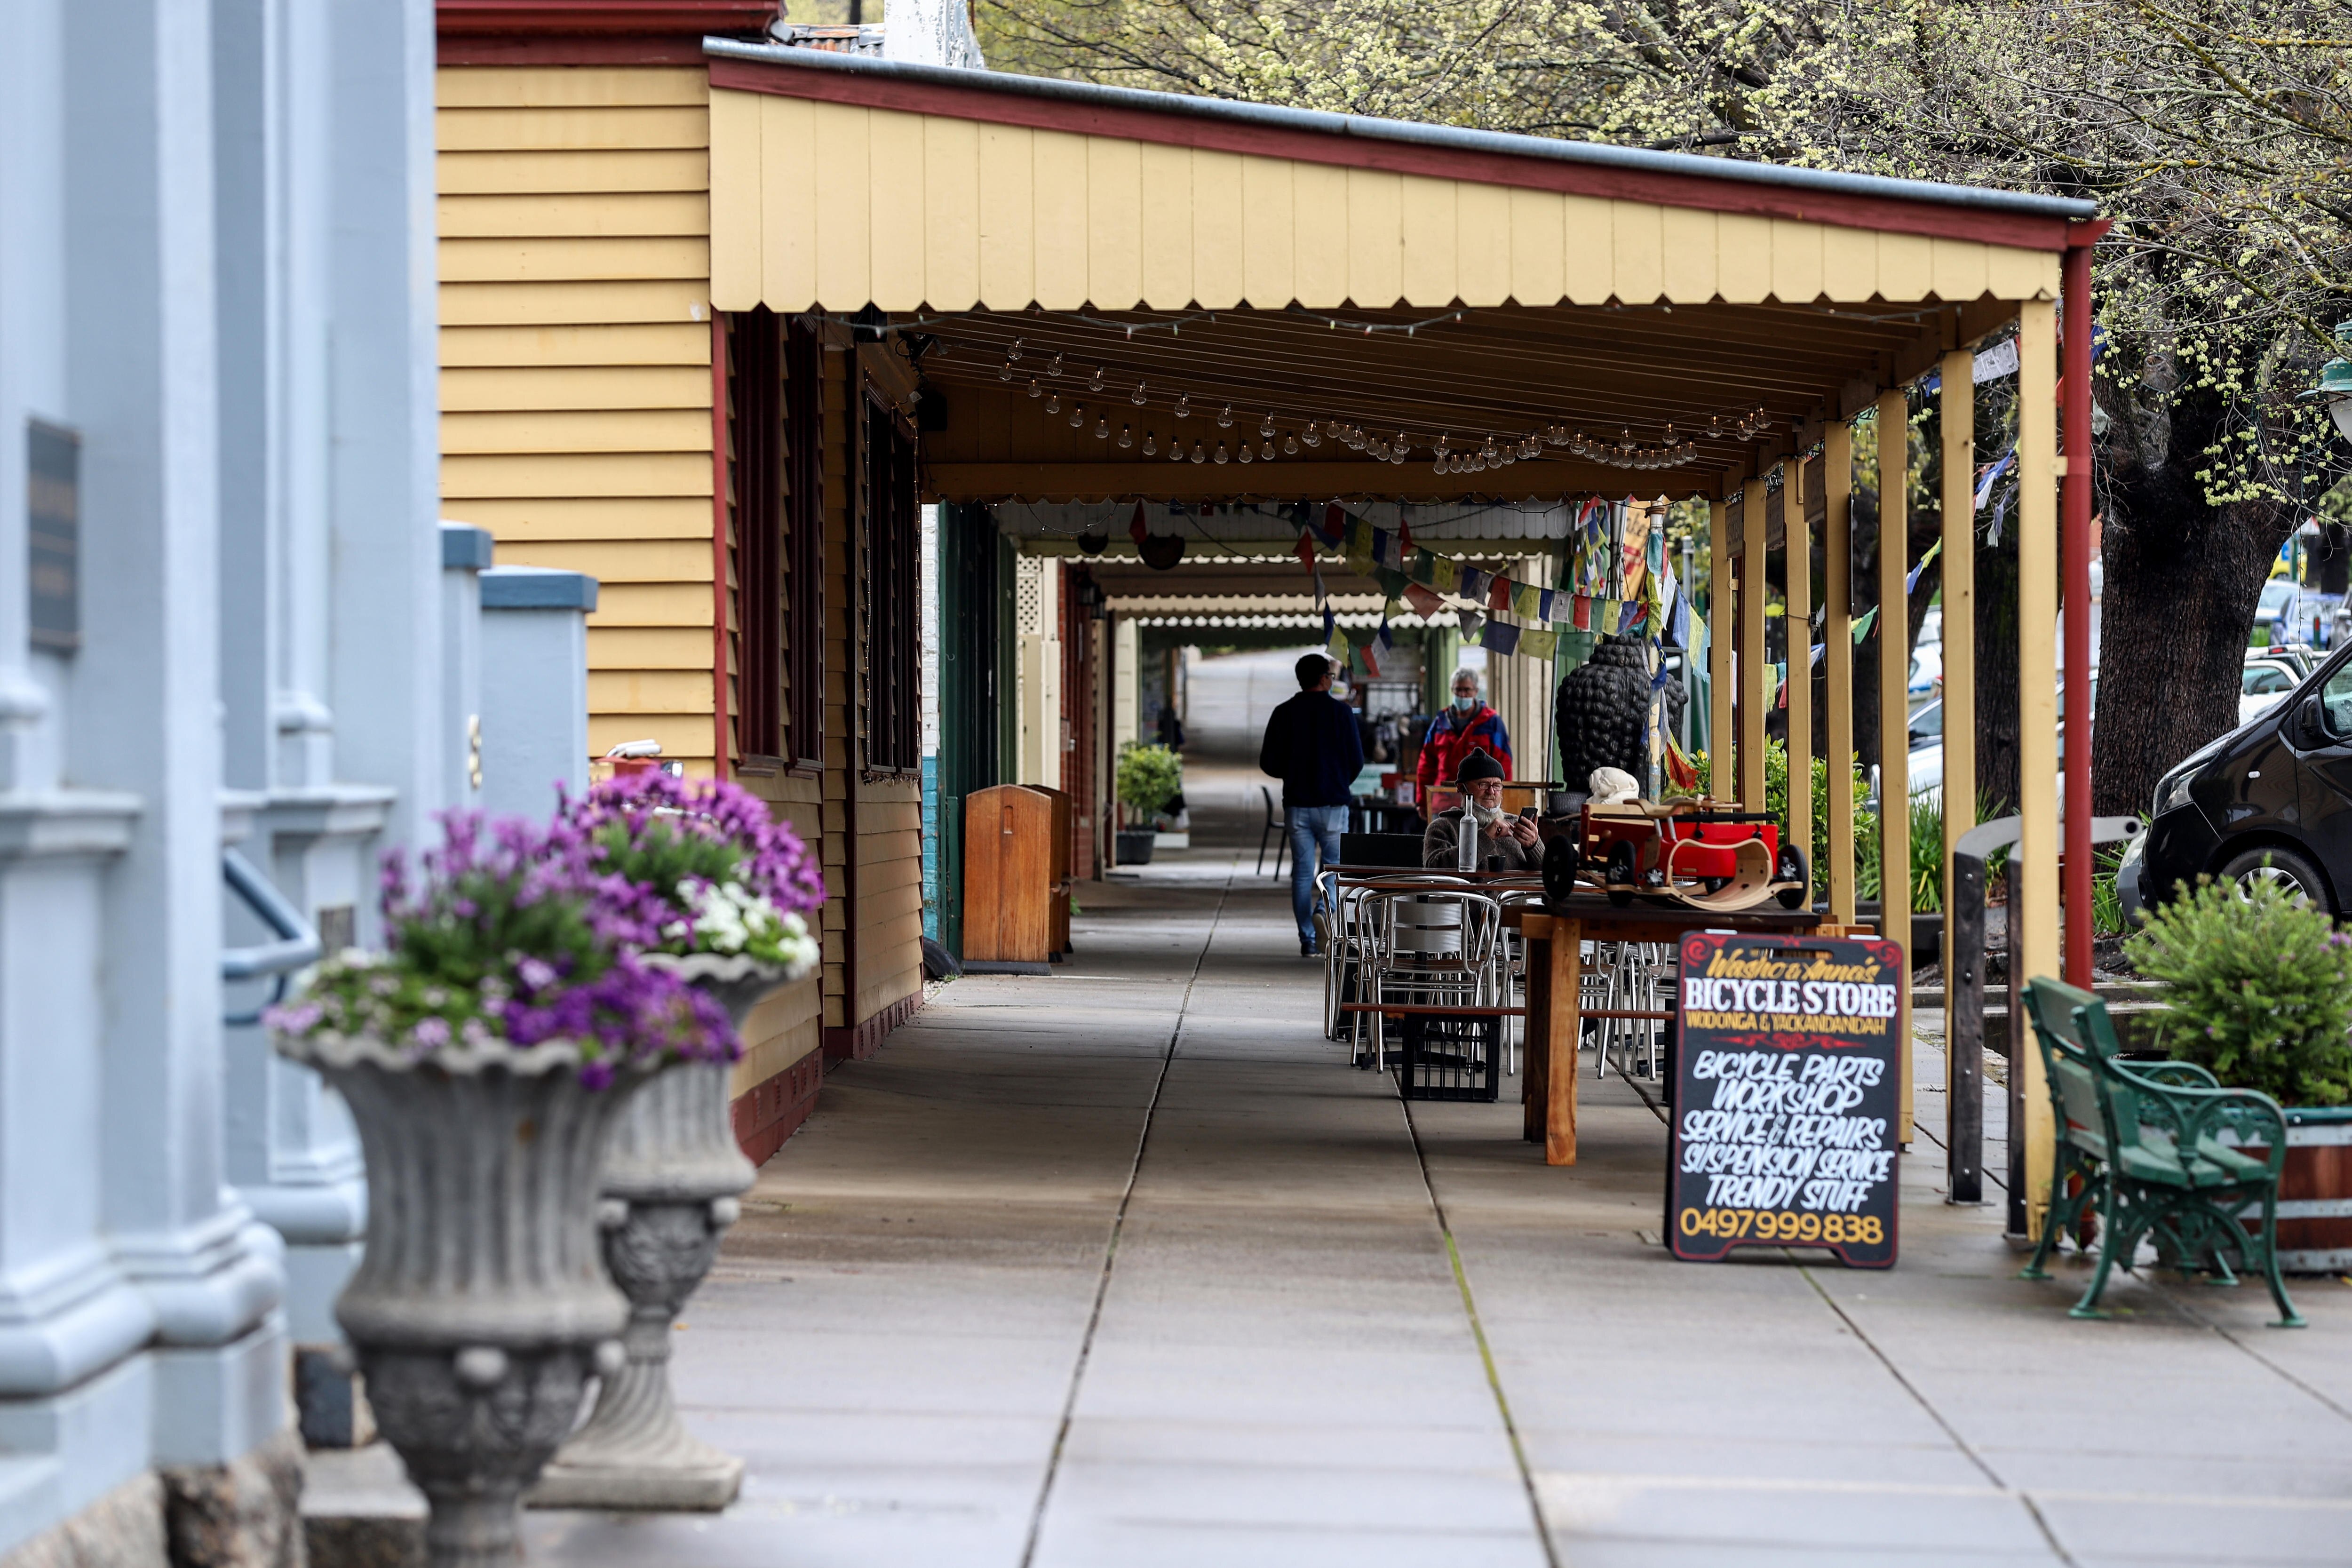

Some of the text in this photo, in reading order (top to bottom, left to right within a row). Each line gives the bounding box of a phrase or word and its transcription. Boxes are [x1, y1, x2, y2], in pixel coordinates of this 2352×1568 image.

[1684, 978, 1897, 1018] BICYCLE STORE
[1685, 1011, 1886, 1035] WODONGA & YACKANDANDAH
[1693, 1050, 1885, 1086] BICYCLE PARTS
[1712, 1079, 1864, 1115] WORKSHOP
[1678, 1110, 1886, 1149] SERVICE & REPAIRS
[1680, 1143, 1895, 1182] SUSPENSION SERVICE
[1705, 1175, 1874, 1212] TRENDY STUFF
